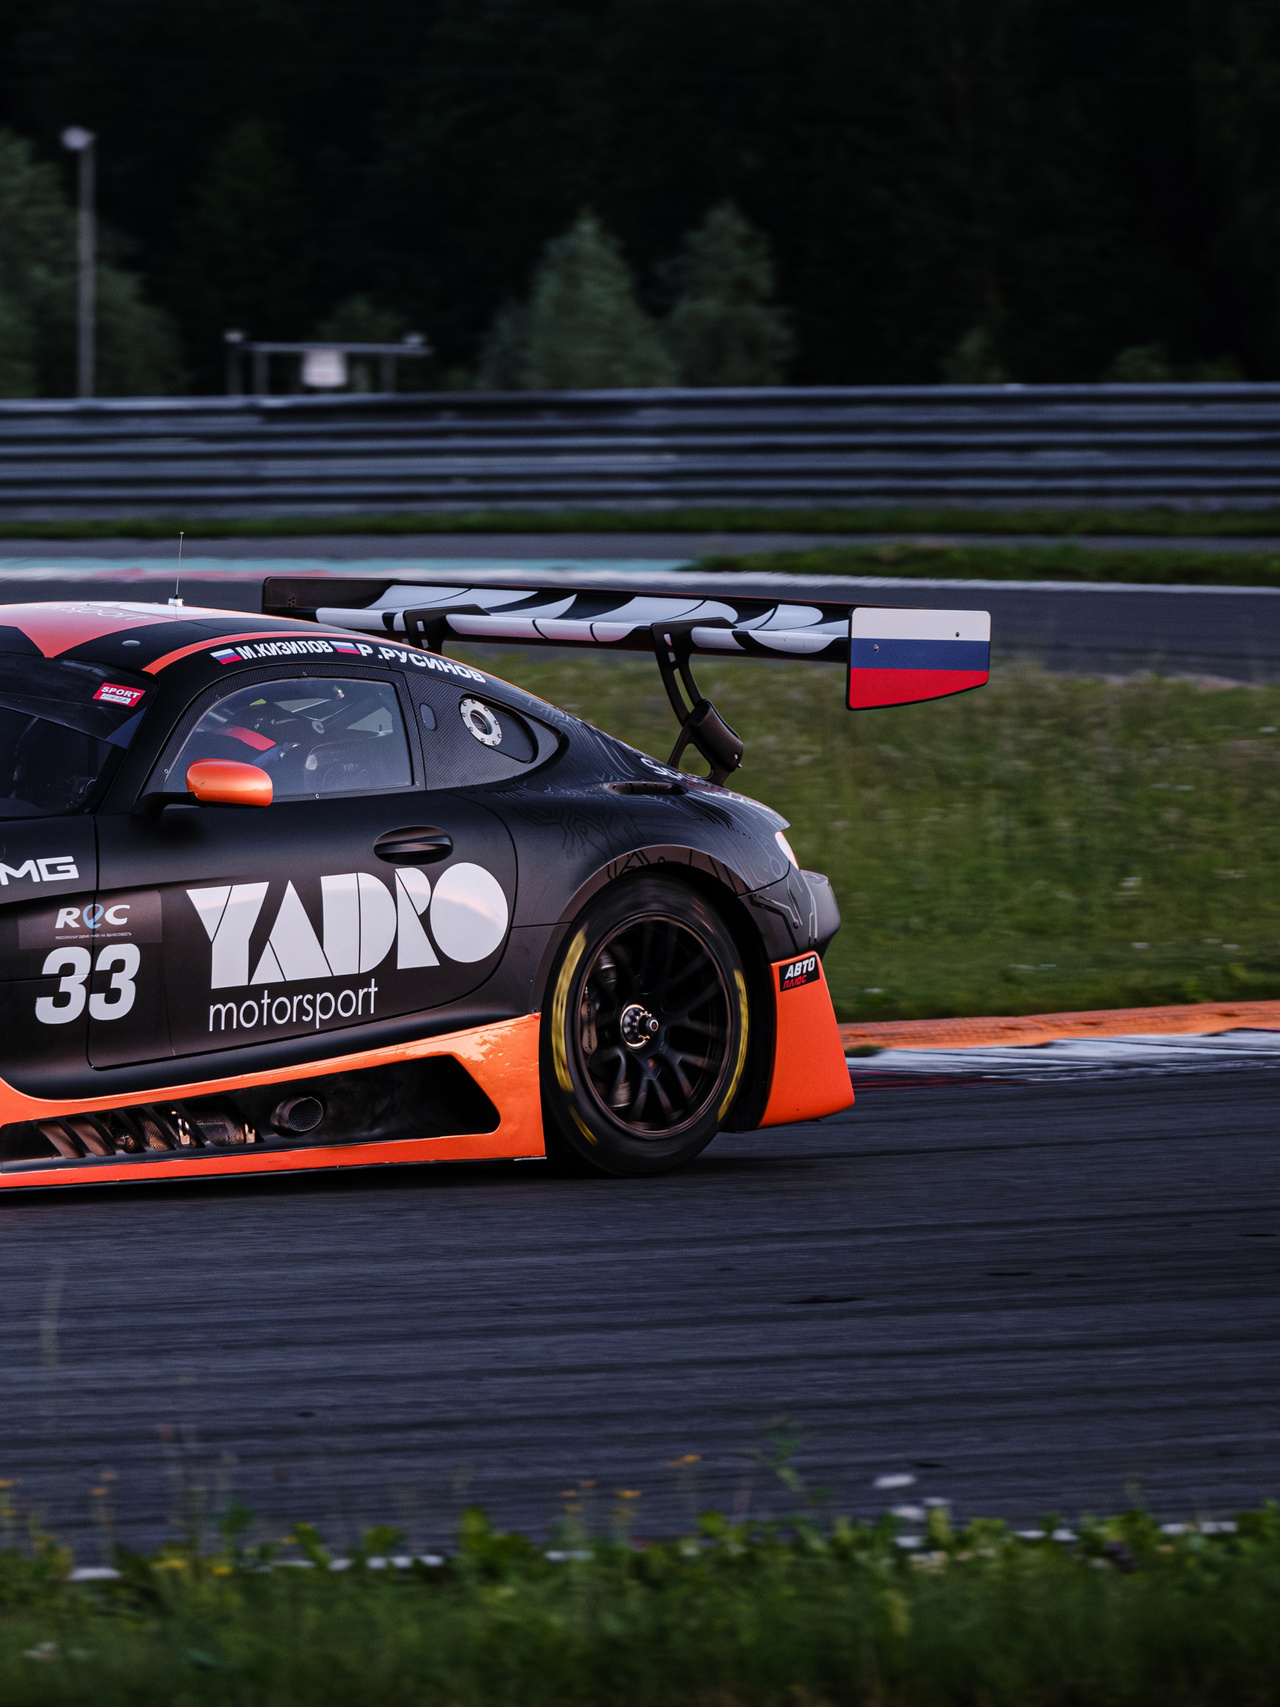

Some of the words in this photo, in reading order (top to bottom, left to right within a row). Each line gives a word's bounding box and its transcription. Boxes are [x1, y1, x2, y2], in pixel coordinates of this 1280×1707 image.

[237, 640, 334, 660] М.КИЗИЛОВ
[101, 686, 141, 699] SPORT
[186, 862, 508, 989] YADRO
[785, 957, 816, 980] АВТО
[35, 943, 141, 1025] 33
[782, 974, 807, 989] ПЛЮС
[209, 978, 378, 1031] motorsport
